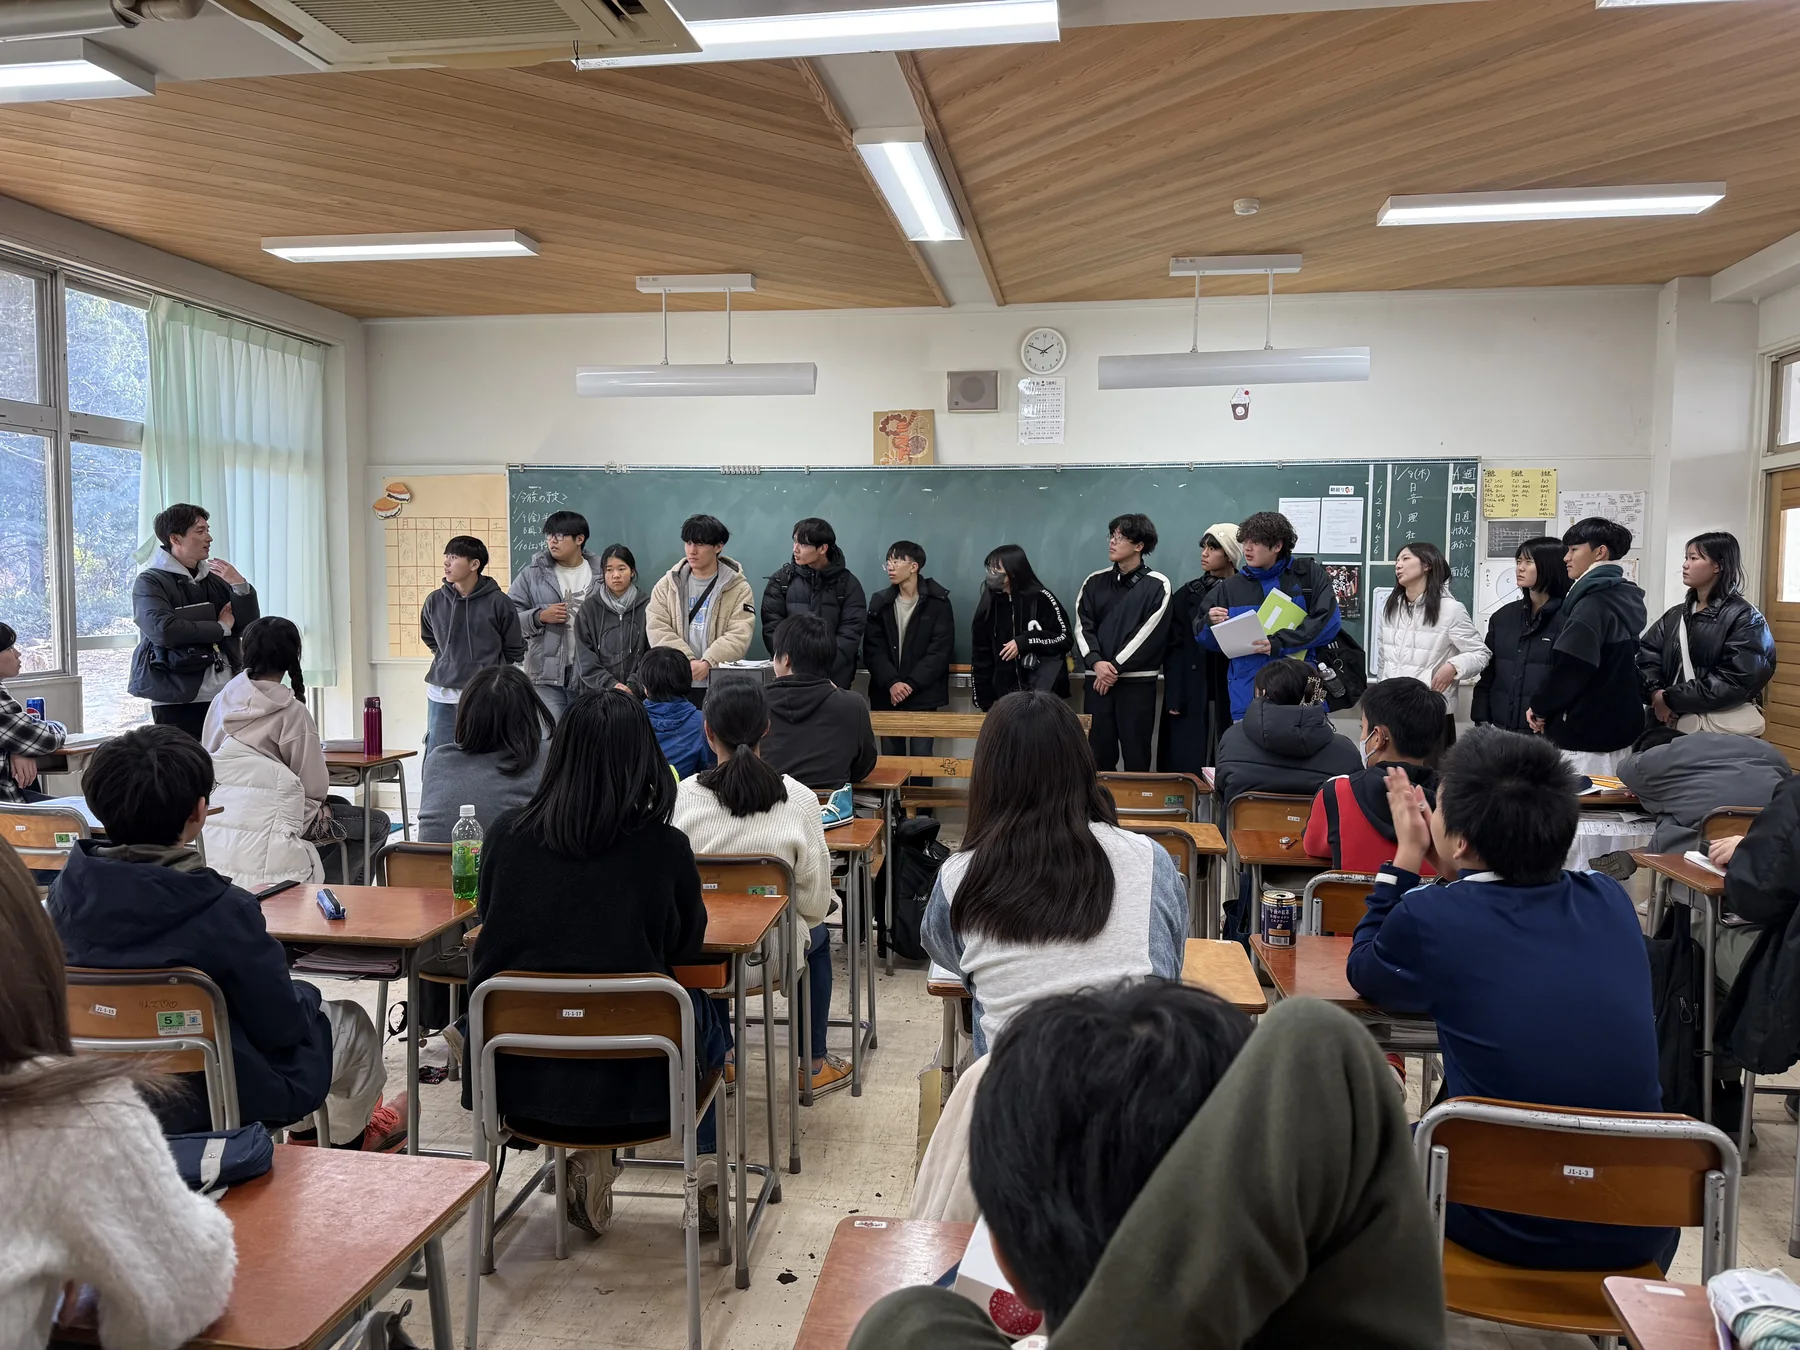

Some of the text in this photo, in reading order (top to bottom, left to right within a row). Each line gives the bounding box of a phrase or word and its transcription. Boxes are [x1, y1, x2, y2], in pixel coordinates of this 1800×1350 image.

[1377, 508, 1382, 517] 3
[1407, 512, 1418, 523] 理
[1376, 522, 1382, 531] 4
[1375, 536, 1381, 544] 5
[1374, 545, 1379, 554] 6
[164, 1016, 173, 1025] 5
[1567, 1168, 1589, 1176] J1-1-3
